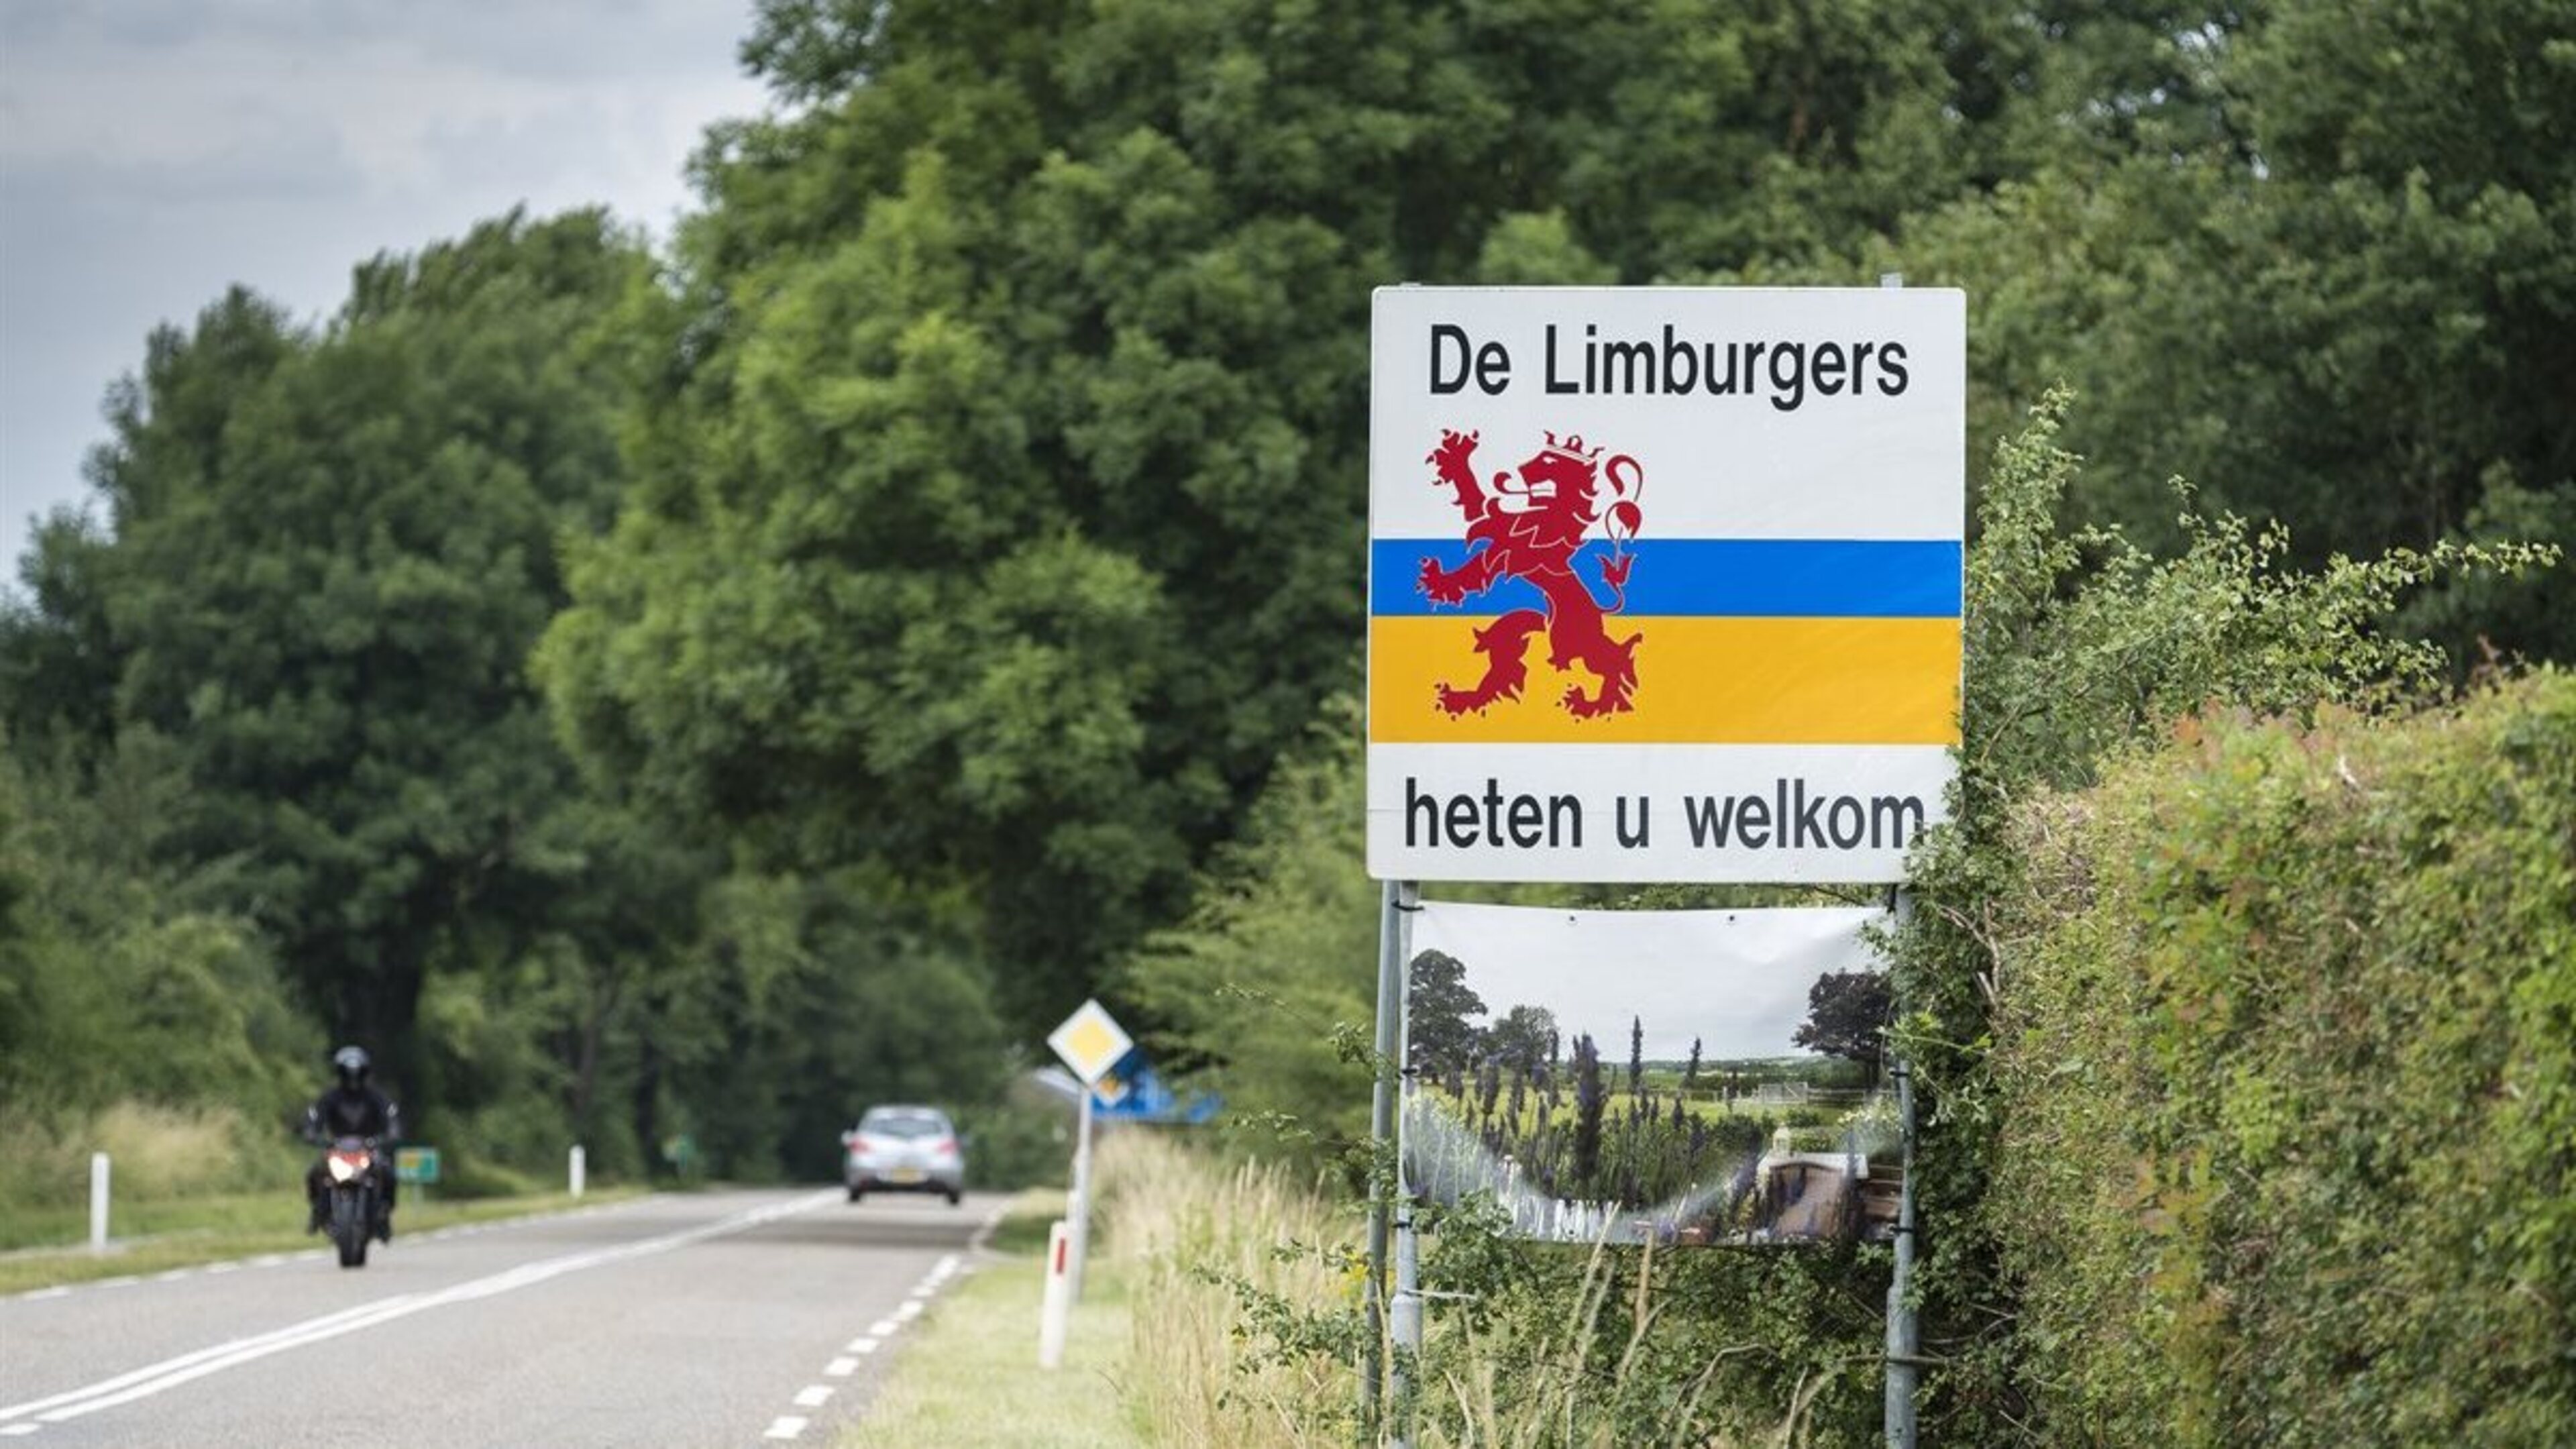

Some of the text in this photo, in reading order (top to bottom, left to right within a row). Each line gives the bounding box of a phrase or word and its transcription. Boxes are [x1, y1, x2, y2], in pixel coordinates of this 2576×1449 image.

[1430, 324, 1909, 412] De Limburgers
[1405, 777, 1924, 849] heten u welkom
